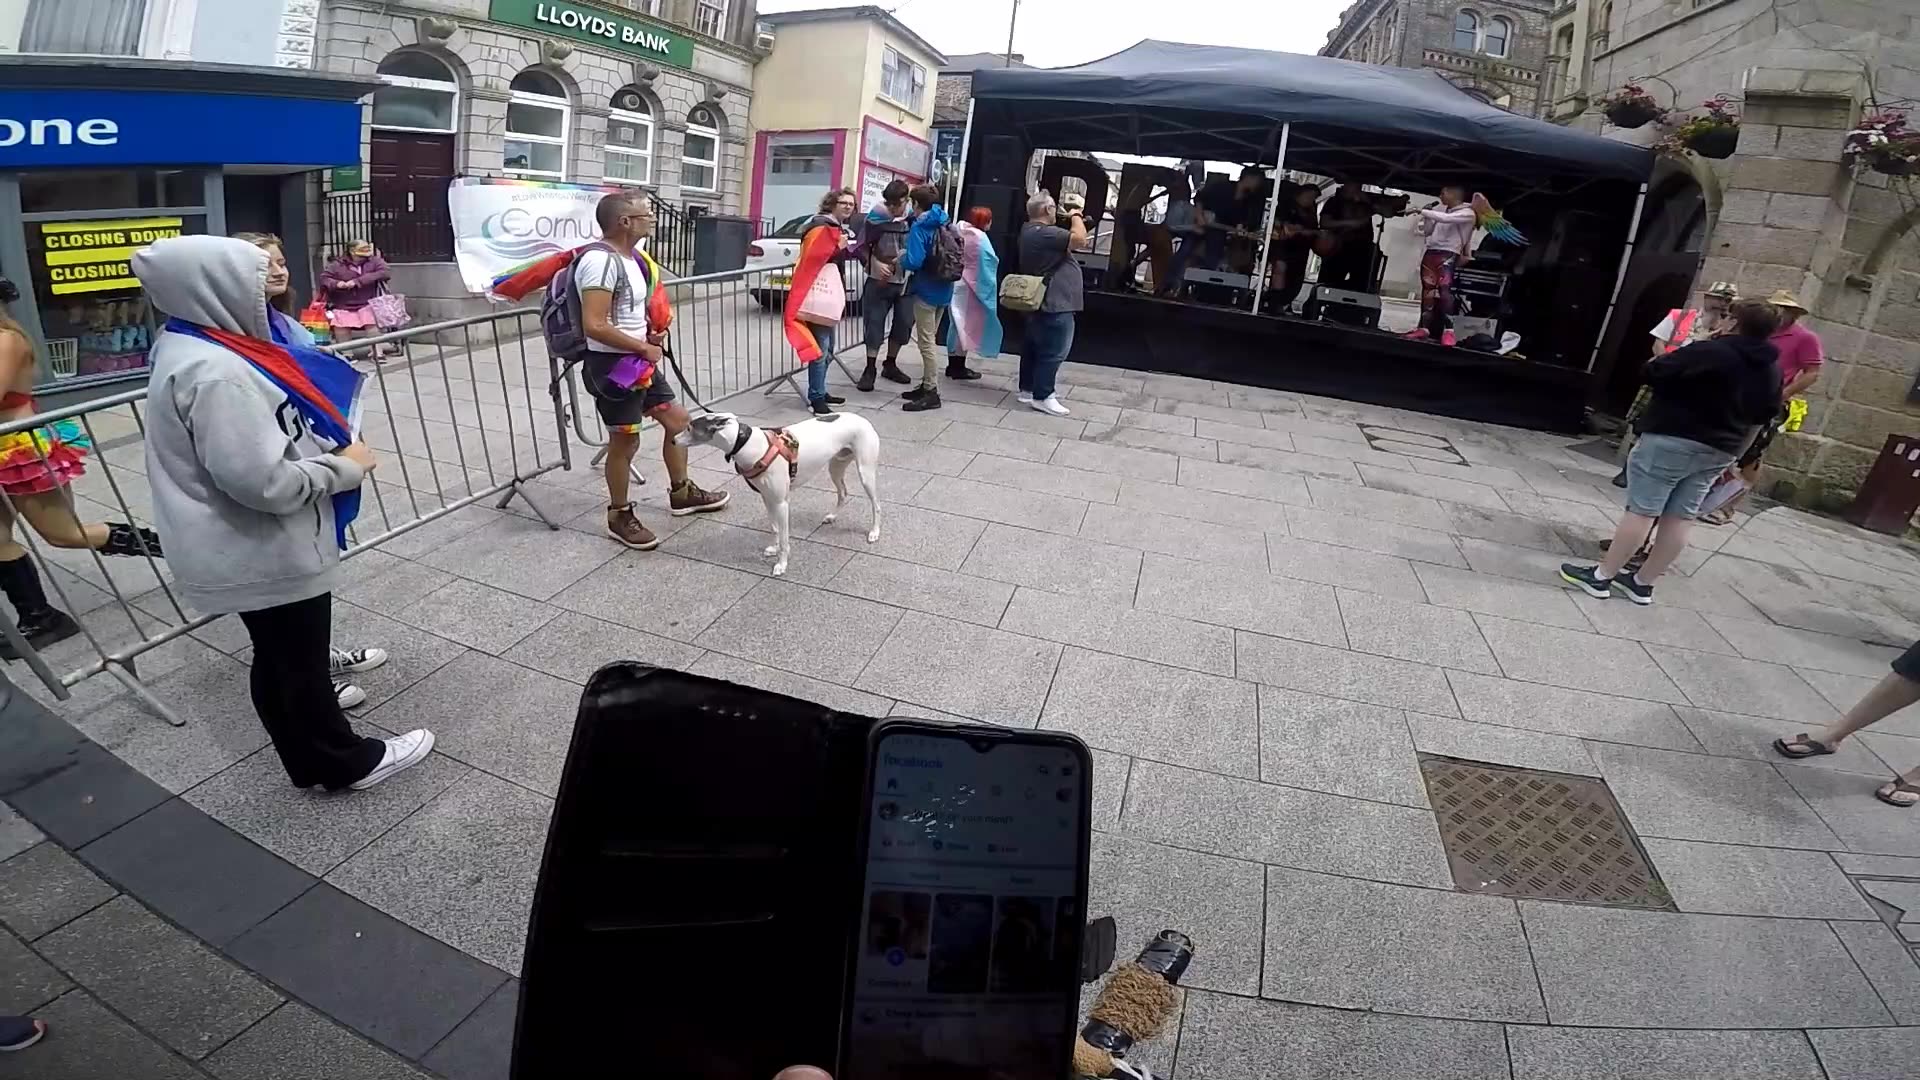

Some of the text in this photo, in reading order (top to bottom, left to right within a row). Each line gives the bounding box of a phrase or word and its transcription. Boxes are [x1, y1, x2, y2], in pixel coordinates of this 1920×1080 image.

[537, 3, 671, 54] LLOYDS BANK
[0, 118, 119, 147] one
[500, 207, 605, 240] Cornw
[46, 229, 181, 248] CLOSING DOWN
[51, 263, 129, 280] CLOSING
